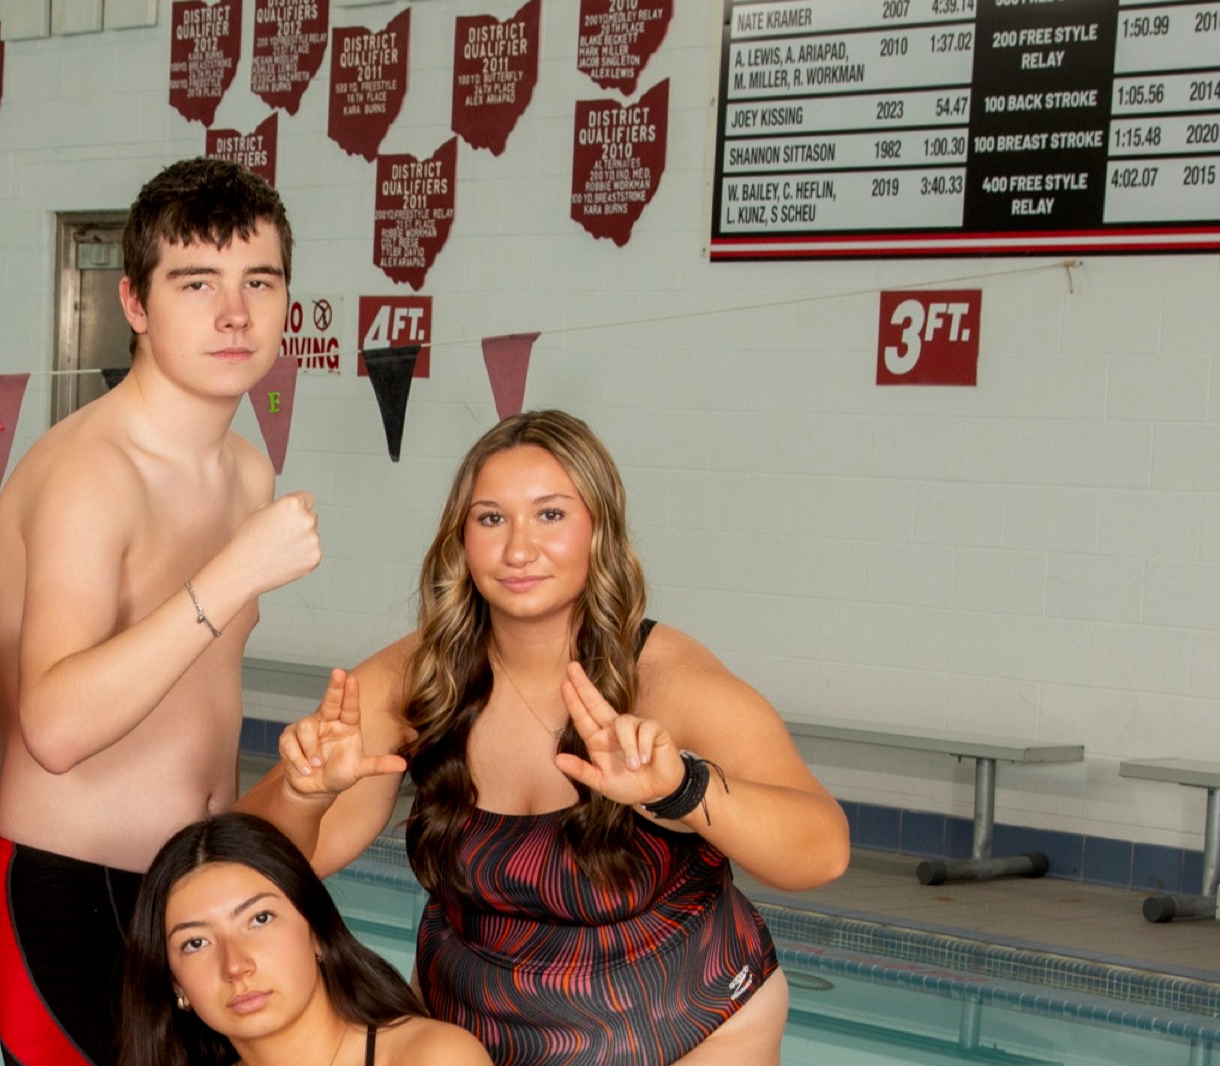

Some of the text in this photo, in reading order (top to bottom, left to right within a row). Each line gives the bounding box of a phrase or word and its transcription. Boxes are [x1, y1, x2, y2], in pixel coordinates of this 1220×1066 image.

[183, 5, 230, 24] DISTRICT
[257, 4, 318, 23] QUALIFIERS
[638, 8, 663, 20] RELAY
[737, 11, 764, 31] NATE
[766, 8, 812, 28] KRAMER
[882, 0, 910, 18] 2007
[176, 20, 229, 40] QUALIFIER
[277, 20, 301, 36] 2012
[469, 22, 525, 43] DISTRICT
[1122, 11, 1220, 38] 1:50.99 201
[194, 36, 218, 52] 2012
[344, 32, 396, 52] DISTRICT
[580, 33, 638, 46] BLAKE BECKETT
[993, 24, 1098, 48] 200 FREE STYLE
[340, 48, 398, 68] QUALIFIER
[464, 39, 527, 59] QUALIFIER
[579, 45, 628, 57] MARK MILLER
[735, 32, 972, 68] A. LEWIS, A. ARIAPAD, 2010 1:37.02
[483, 56, 508, 73] 2011
[579, 56, 640, 68] JACOB SINGLETON
[1021, 51, 1064, 69] RELAY
[358, 65, 382, 82] 2011
[484, 71, 523, 84] BUTTERFLY
[591, 68, 634, 78] ALEX LEWIS
[734, 64, 865, 90] M. MILLER, R. WORKMAN
[362, 79, 396, 92] FREESTYLE
[494, 82, 515, 94] PLACE
[1117, 83, 1164, 106] 1:05.56
[367, 91, 386, 102] PLACE
[465, 95, 483, 106] ALEX
[984, 90, 1098, 112] 100 BACK STROKE
[343, 103, 386, 116] KARA BURNS
[589, 107, 650, 127] DISTRICT
[732, 97, 968, 128] JOEY KISSING 2023 54.47
[217, 136, 263, 153] DISTRICT
[579, 125, 656, 145] QUALIFIERS
[974, 130, 1103, 152] 100 BREAST STROKE
[1114, 124, 1218, 148] 1:15.48 2020
[602, 142, 632, 159] 2010
[730, 137, 965, 166] SHANNON SITTASON 1982 1:00.30
[392, 161, 442, 180] DISTRICT
[594, 158, 641, 170] ALTERNATES
[585, 180, 650, 191] ROBBIE WORKMAN
[982, 173, 1088, 192] 400 FREE STYLE
[1111, 166, 1215, 188] 4:02.07 2015
[382, 178, 448, 196] QUALIFIERS
[728, 176, 962, 202] W. BAILEY, C. HEFLIN, 2019 3:40.33
[403, 194, 427, 209] 2011
[584, 203, 628, 215] KARA BURNS
[1012, 198, 1054, 215] RELAY
[727, 204, 816, 226] L. KUNZ, S SCHEU
[363, 305, 425, 350] 4FT.
[884, 299, 970, 375] 3FT.
